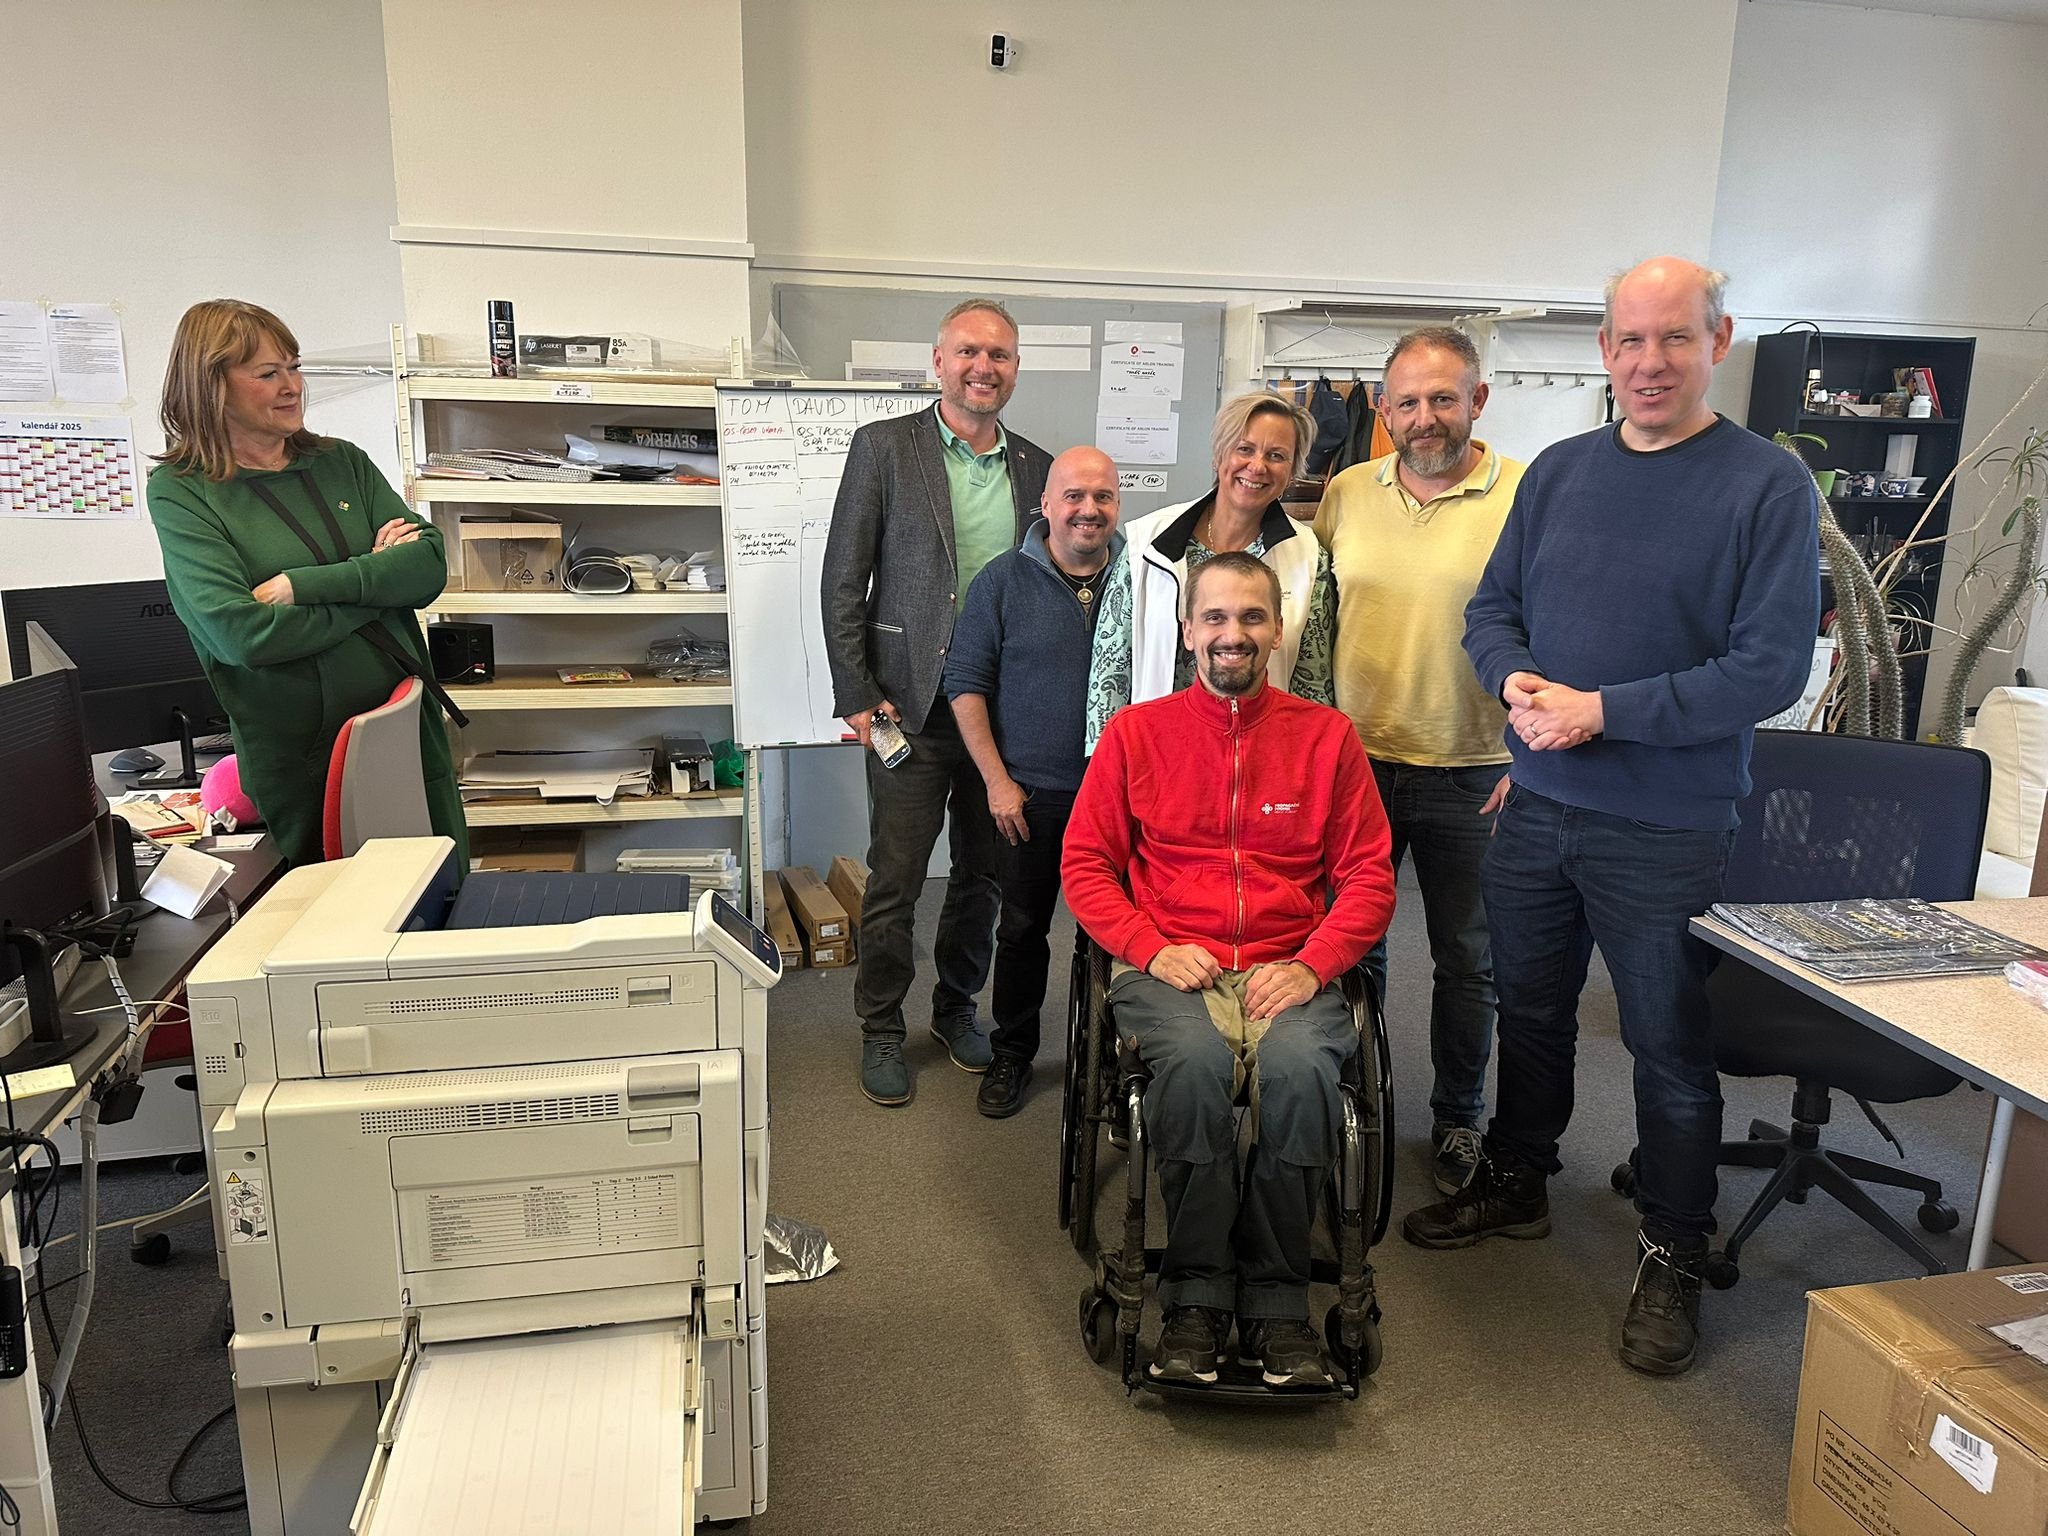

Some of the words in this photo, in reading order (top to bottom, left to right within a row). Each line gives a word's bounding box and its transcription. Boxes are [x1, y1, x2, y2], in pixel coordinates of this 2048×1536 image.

[525, 339, 537, 352] hp
[612, 338, 628, 347] 85A
[726, 396, 772, 417] TOM
[792, 397, 847, 417] DAVID
[21, 421, 59, 429] kalendář
[60, 423, 82, 431] 2025
[635, 432, 699, 449] SEVERKA
[1825, 1428, 1835, 1441] PO
[1822, 1466, 1857, 1501] DIMENSION
[1821, 1479, 1844, 1503] GROSS
[1843, 1500, 1858, 1516] AND
[1859, 1512, 1882, 1536] NETTO
